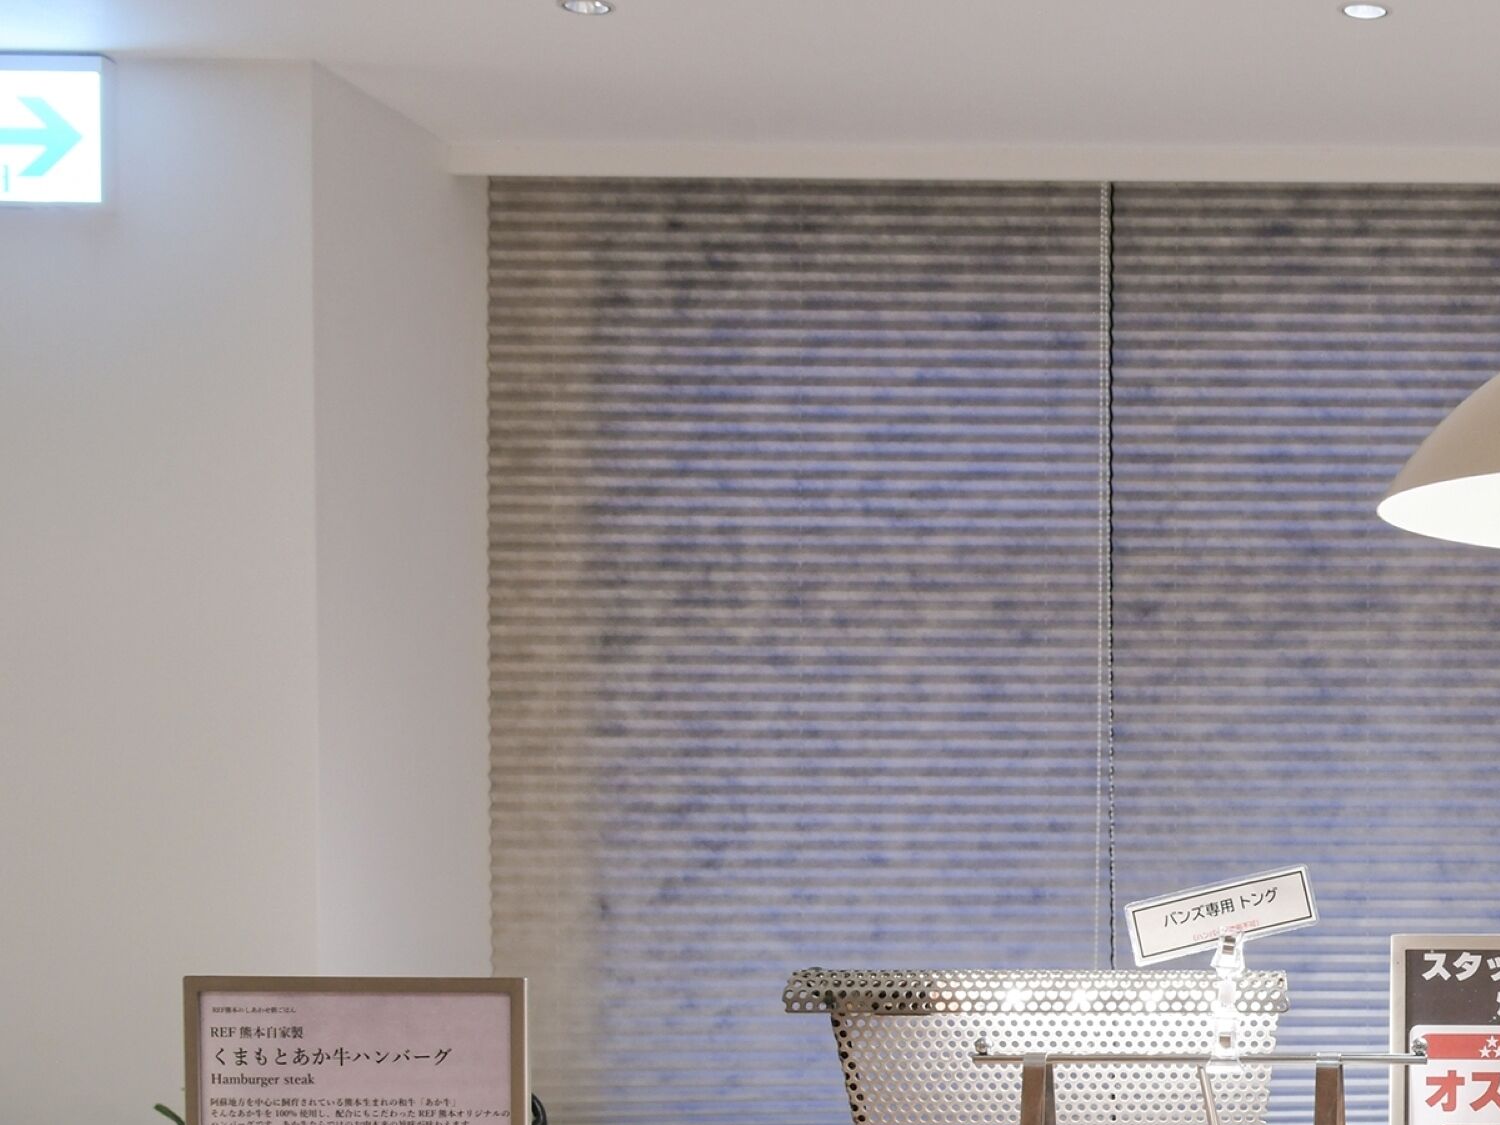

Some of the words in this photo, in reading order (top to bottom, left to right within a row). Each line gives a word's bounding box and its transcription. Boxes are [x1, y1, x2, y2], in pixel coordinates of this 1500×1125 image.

[1164, 898, 1235, 928] バンズ専用
[1239, 887, 1277, 909] トング
[211, 1027, 236, 1037] REF
[240, 1026, 303, 1039] 熊本自家製
[216, 1047, 452, 1066] くまもとあか牛ハンバーグ
[212, 1073, 280, 1087] Hamburger
[284, 1073, 314, 1085] steak
